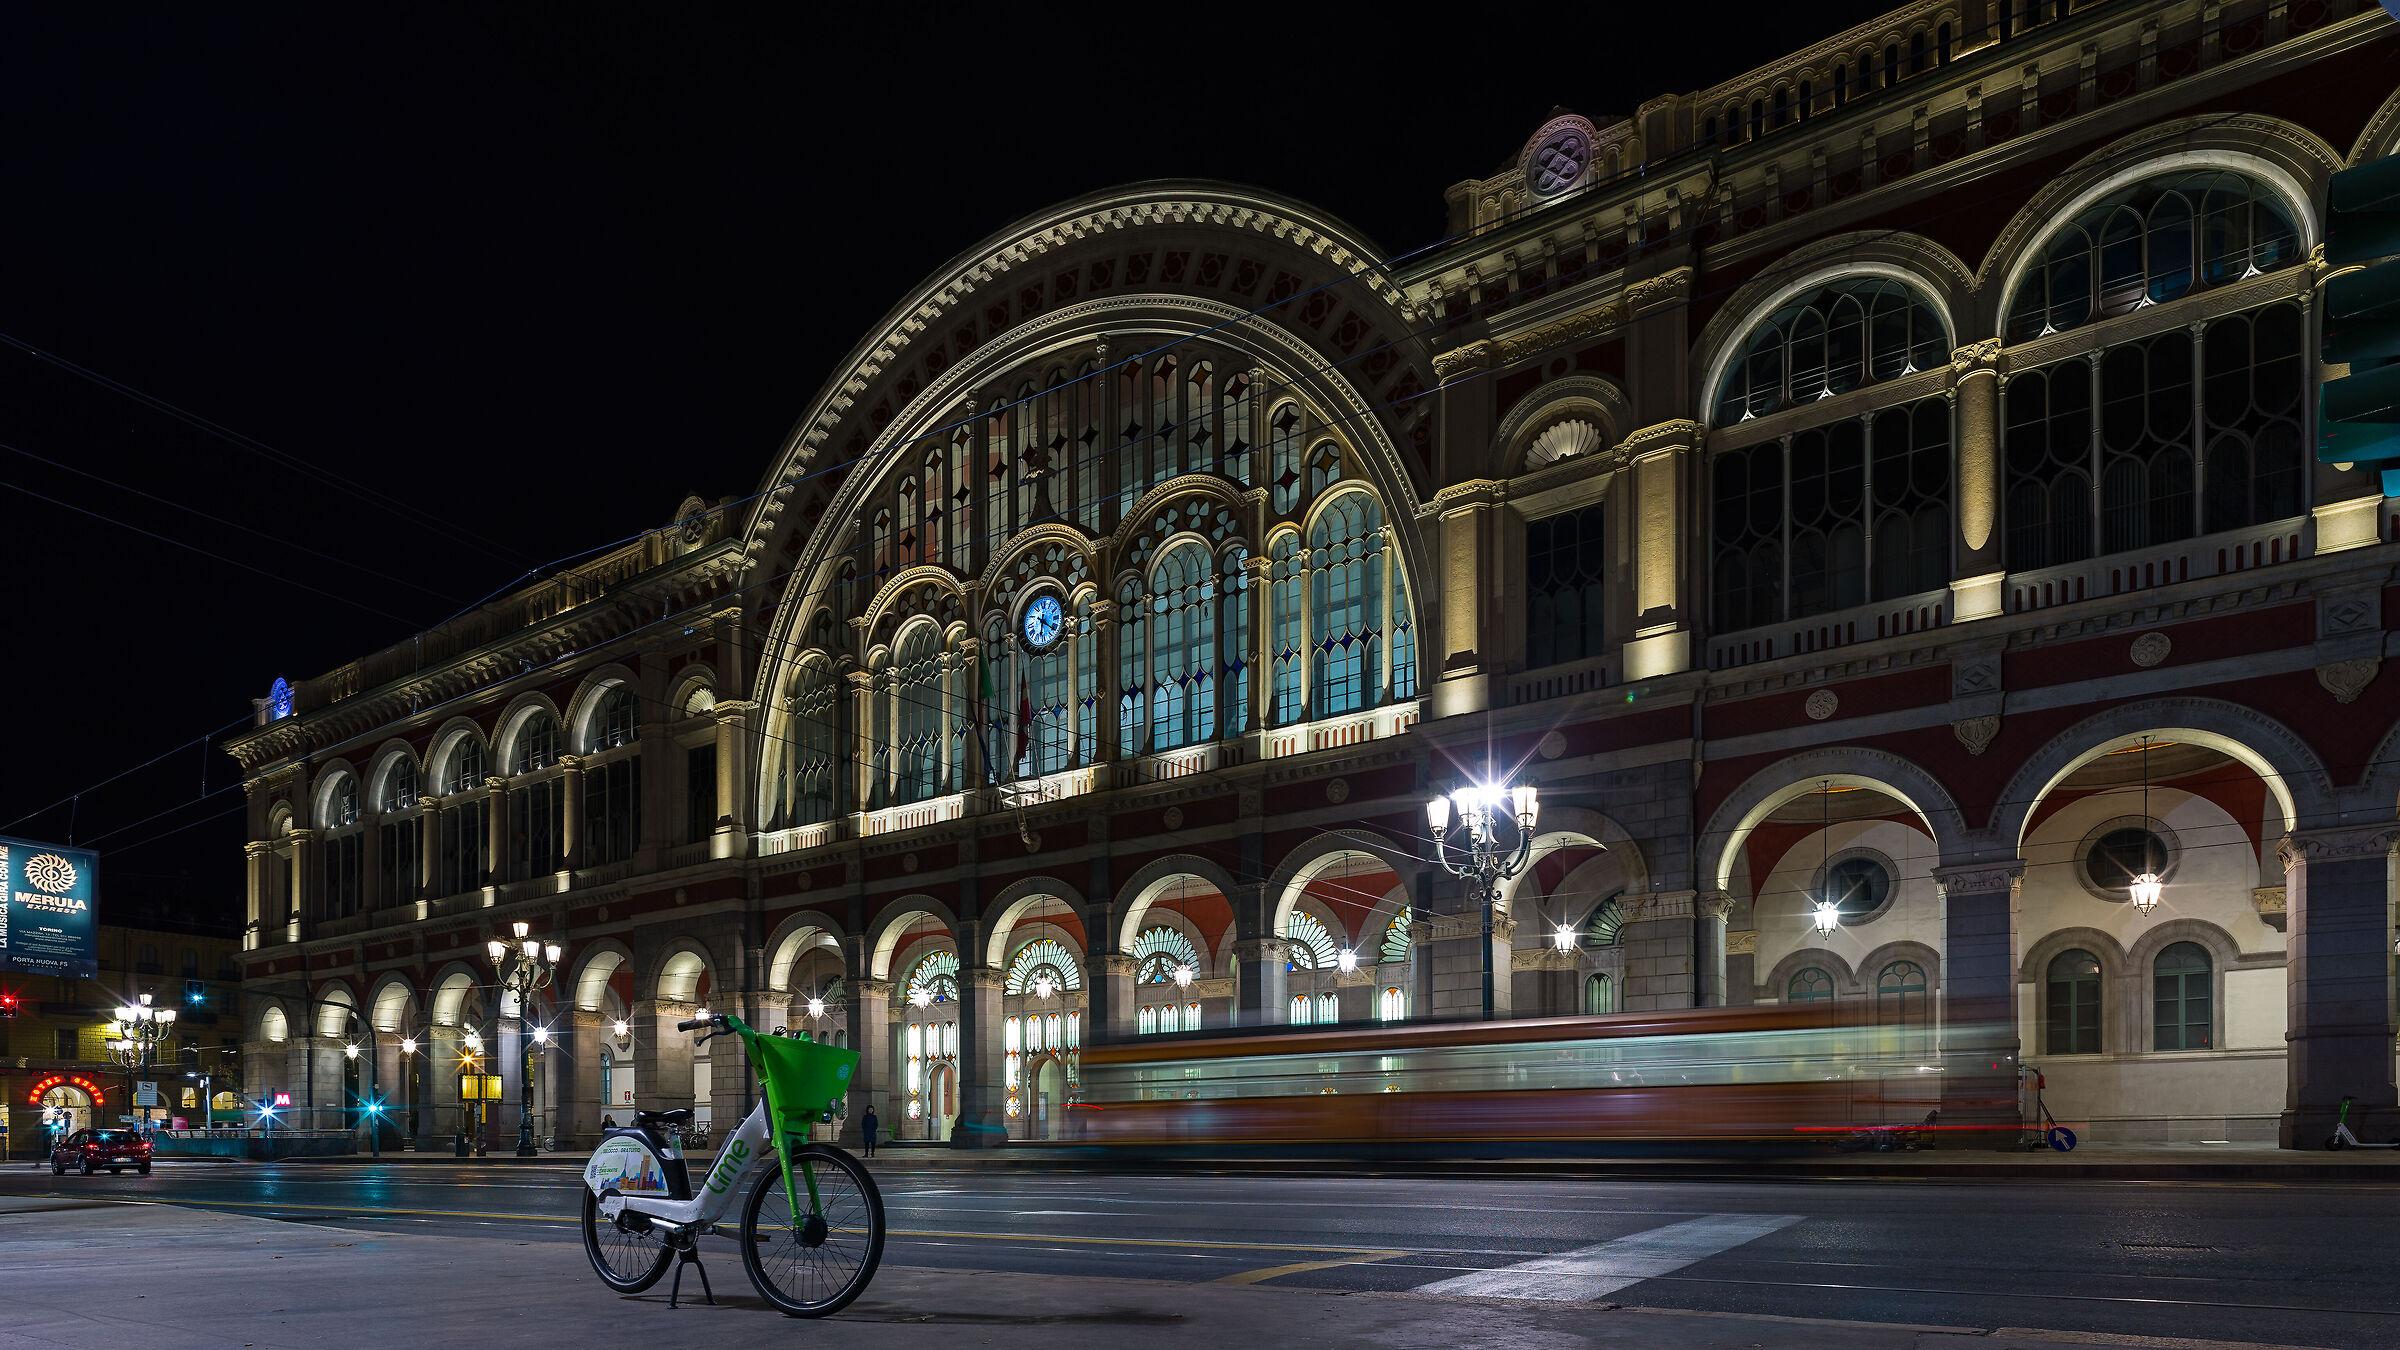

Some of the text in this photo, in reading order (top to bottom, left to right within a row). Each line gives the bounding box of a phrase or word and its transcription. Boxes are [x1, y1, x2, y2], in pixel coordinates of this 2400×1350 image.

[15, 891, 87, 911] MERULA
[27, 903, 78, 915] EXPRESS
[39, 926, 63, 934] TORINO
[12, 956, 35, 964] PORTA
[36, 959, 59, 967] NUOVA
[276, 1094, 290, 1105] M
